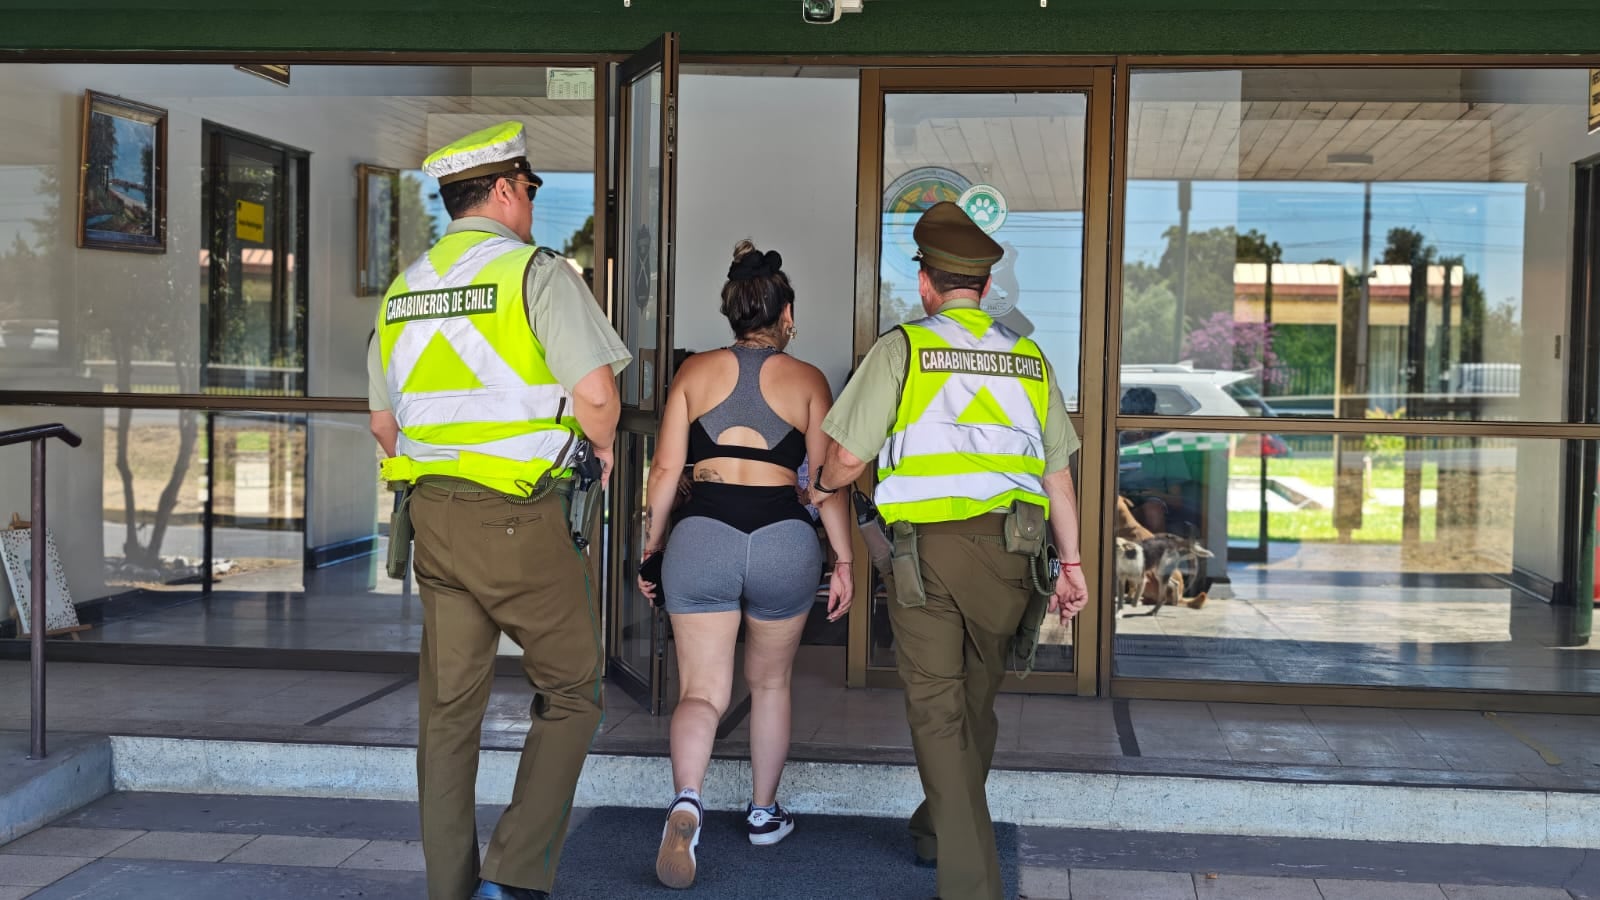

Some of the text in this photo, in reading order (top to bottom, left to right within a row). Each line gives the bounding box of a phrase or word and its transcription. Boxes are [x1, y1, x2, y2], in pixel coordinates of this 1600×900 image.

[387, 288, 494, 320] CARABINEROS DE CHILE
[922, 351, 1042, 378] CARABINEROS DE CHILE
